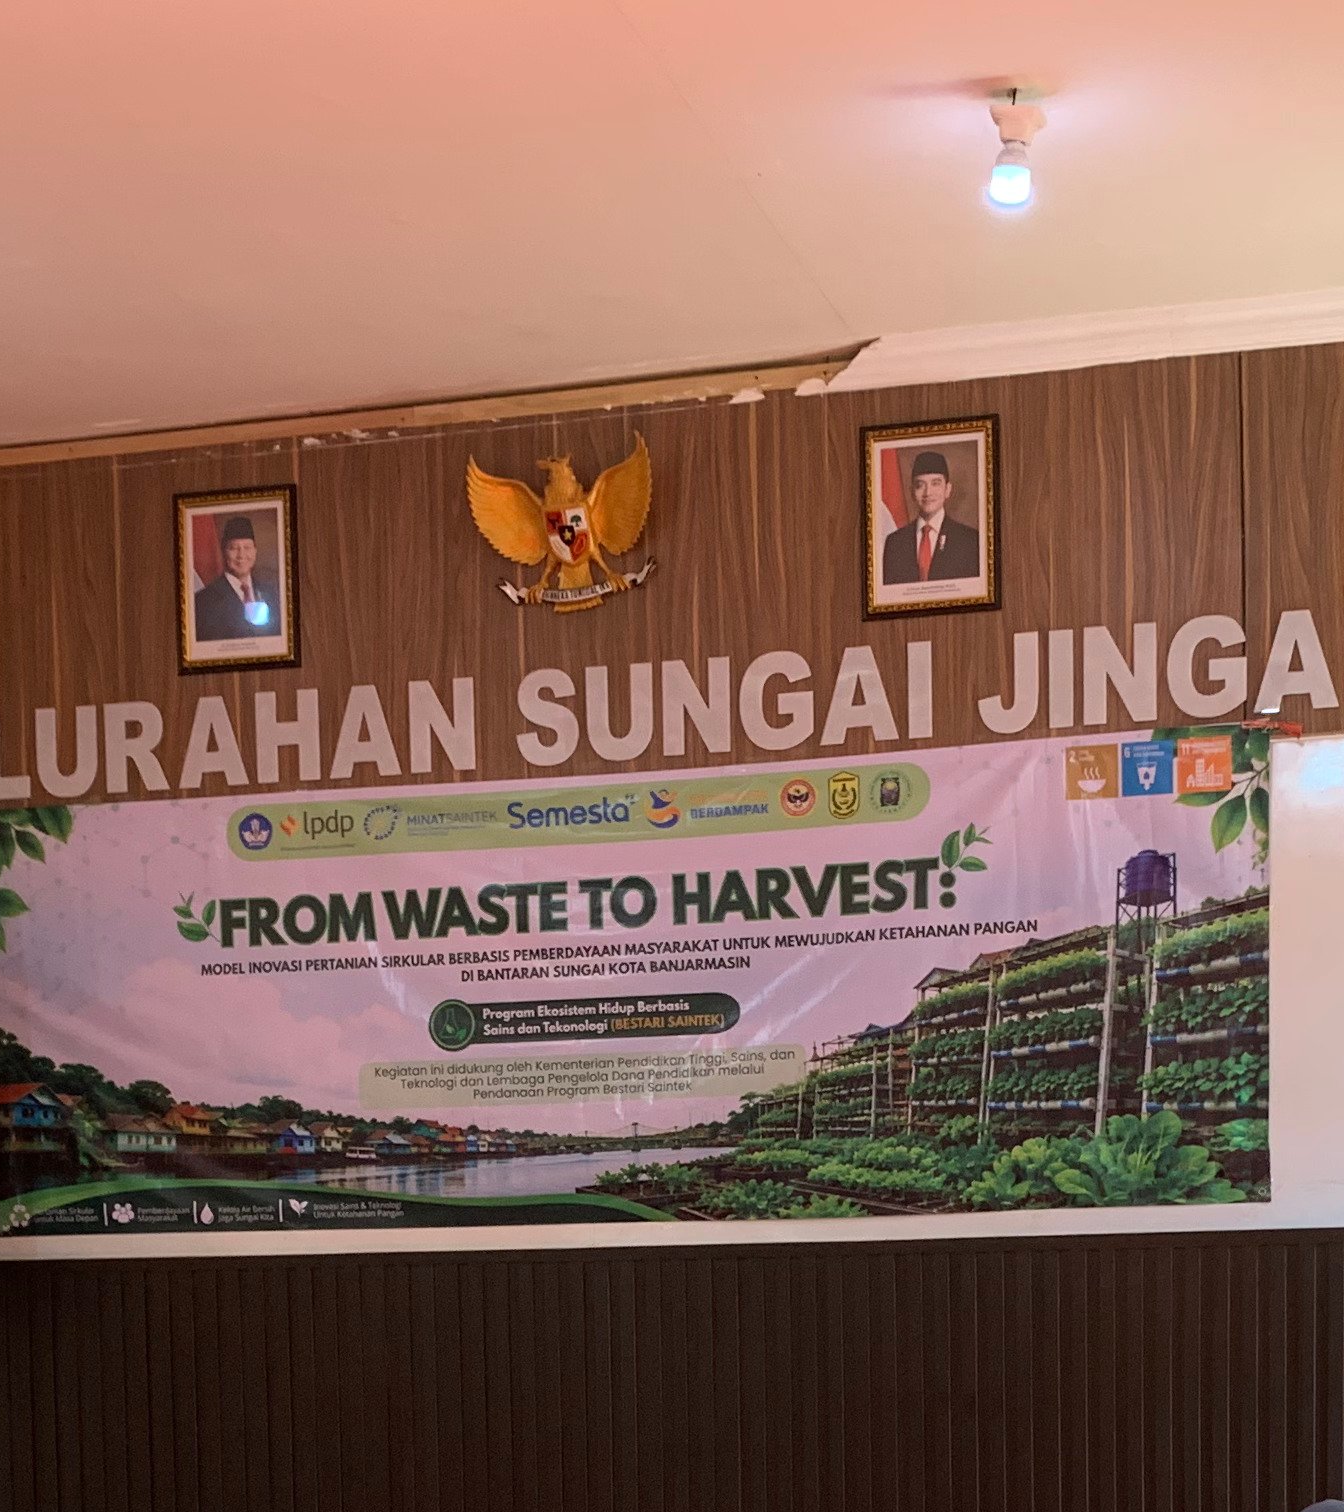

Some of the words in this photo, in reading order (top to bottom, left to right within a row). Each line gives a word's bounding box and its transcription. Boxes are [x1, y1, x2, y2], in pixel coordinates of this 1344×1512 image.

[516, 640, 935, 767] SUNGAI
[303, 810, 355, 839] lpdp
[507, 796, 629, 830] Semesta
[219, 891, 378, 948] FROM
[381, 881, 568, 940] WASTE
[578, 875, 658, 930] TO
[671, 857, 957, 926] HARVEST:
[201, 962, 245, 976] MODEL
[248, 960, 302, 974] INOVASI
[305, 956, 378, 972] PERTANIAN
[381, 952, 446, 969] SIRKULAR
[449, 949, 510, 965] BERBASIS
[513, 944, 621, 963] PEMBERDAYAAN
[624, 939, 719, 957] MASYARAKAT
[723, 935, 771, 951] UNTUK
[774, 929, 876, 948] MEWUJUDKAN
[879, 923, 970, 941] KETAHANAN
[973, 919, 1039, 935] PANGAN
[461, 968, 475, 982] DI
[478, 966, 550, 981] BANTARAN
[553, 963, 606, 978] SUNGAI
[608, 960, 647, 975] KOTA
[650, 955, 751, 973] BANJARMASIN
[482, 1006, 535, 1023] Program
[537, 1003, 595, 1018] Ekosistem
[598, 1001, 636, 1018] Hidup
[637, 998, 690, 1013] Berbasis
[483, 1022, 516, 1036] Sains
[518, 1021, 540, 1034] dan
[542, 1018, 609, 1036] Tekonologi
[611, 1014, 665, 1034] (BESTARI
[667, 1012, 726, 1030] SAINTEK)
[374, 1064, 428, 1081] Kegiatan
[430, 1063, 444, 1076] ini
[447, 1061, 504, 1078] didukung
[506, 1059, 532, 1073] oleh
[535, 1056, 615, 1072] Kementerian
[618, 1053, 687, 1069] Pendidikan
[689, 1051, 729, 1068] Tinggi,
[731, 1049, 767, 1065] Sains,
[769, 1048, 796, 1062] dan
[401, 1076, 457, 1092] Teknologi
[459, 1074, 484, 1088] dan
[487, 1071, 545, 1089] Lembaga
[548, 1069, 609, 1087] Pengelola
[611, 1066, 645, 1081] Dana
[647, 1064, 716, 1080] Pendidikan
[718, 1061, 765, 1077] melalui
[473, 1084, 544, 1100] Pendanaan
[546, 1082, 600, 1099] Program
[603, 1080, 645, 1095] Bestari
[647, 1078, 693, 1093] Saintek
